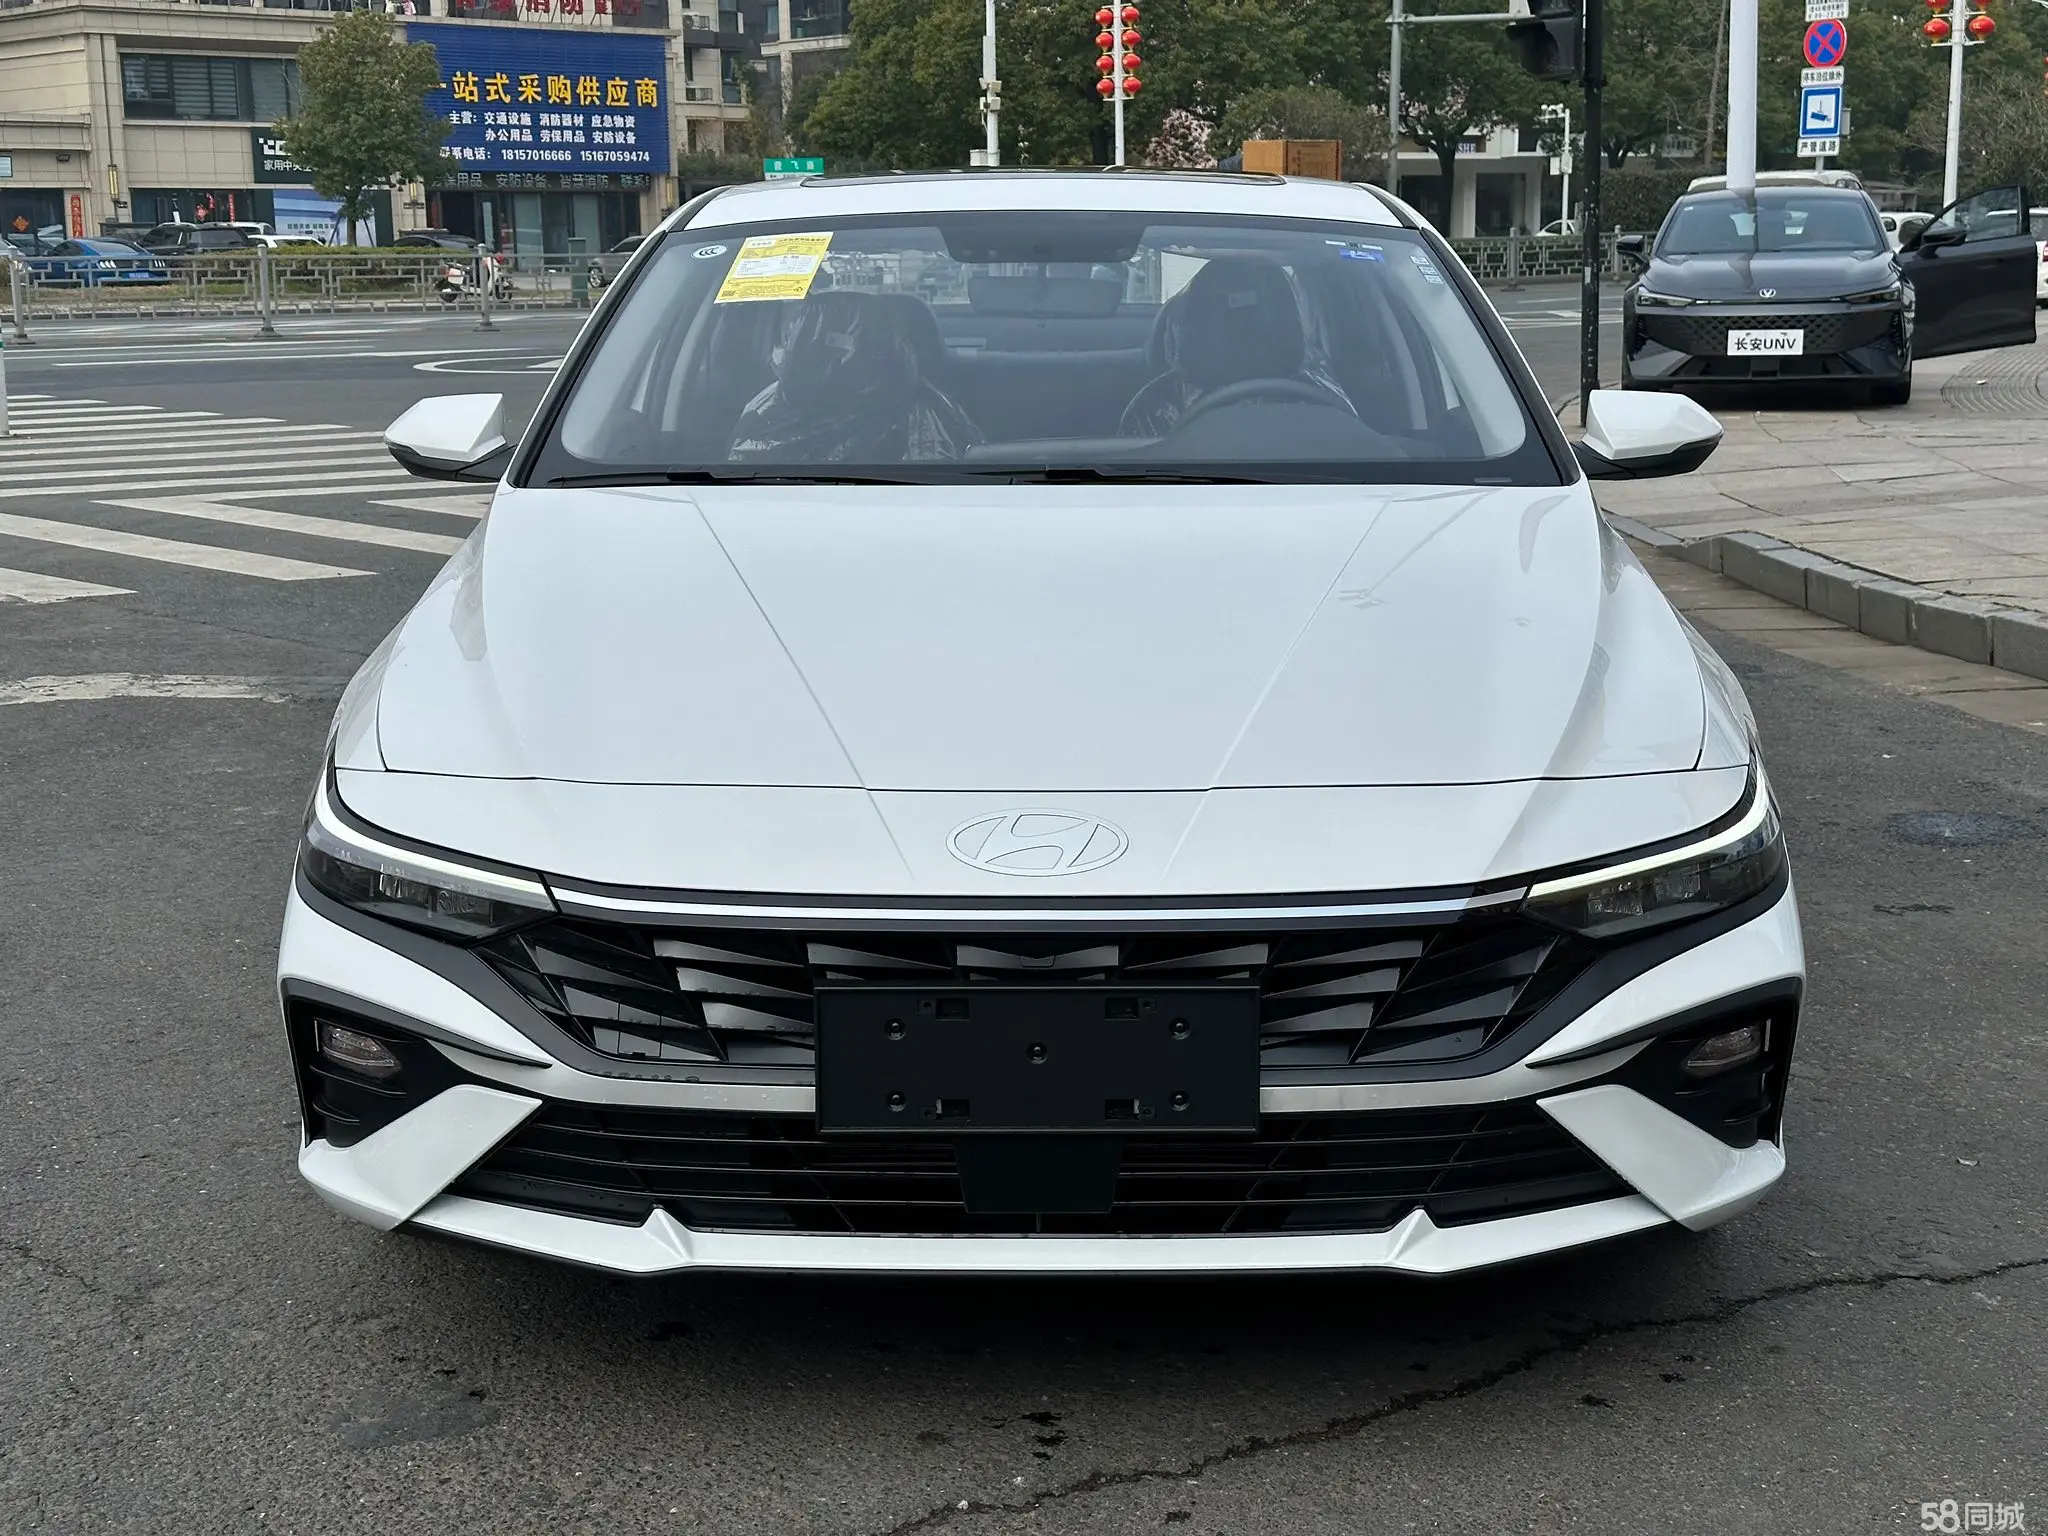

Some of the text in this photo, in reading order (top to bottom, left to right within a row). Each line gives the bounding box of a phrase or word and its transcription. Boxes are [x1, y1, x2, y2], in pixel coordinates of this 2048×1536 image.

[484, 112, 531, 126] 交通设施
[539, 113, 584, 127] 消防器材
[591, 114, 635, 128] 应急物资
[485, 129, 636, 144] 办公用品 劳保用品 安防设备
[1801, 141, 1837, 152] 严管道路
[501, 149, 571, 161] 18157016666
[580, 150, 650, 162] 15167059474
[1735, 337, 1797, 351] 长安UNV
